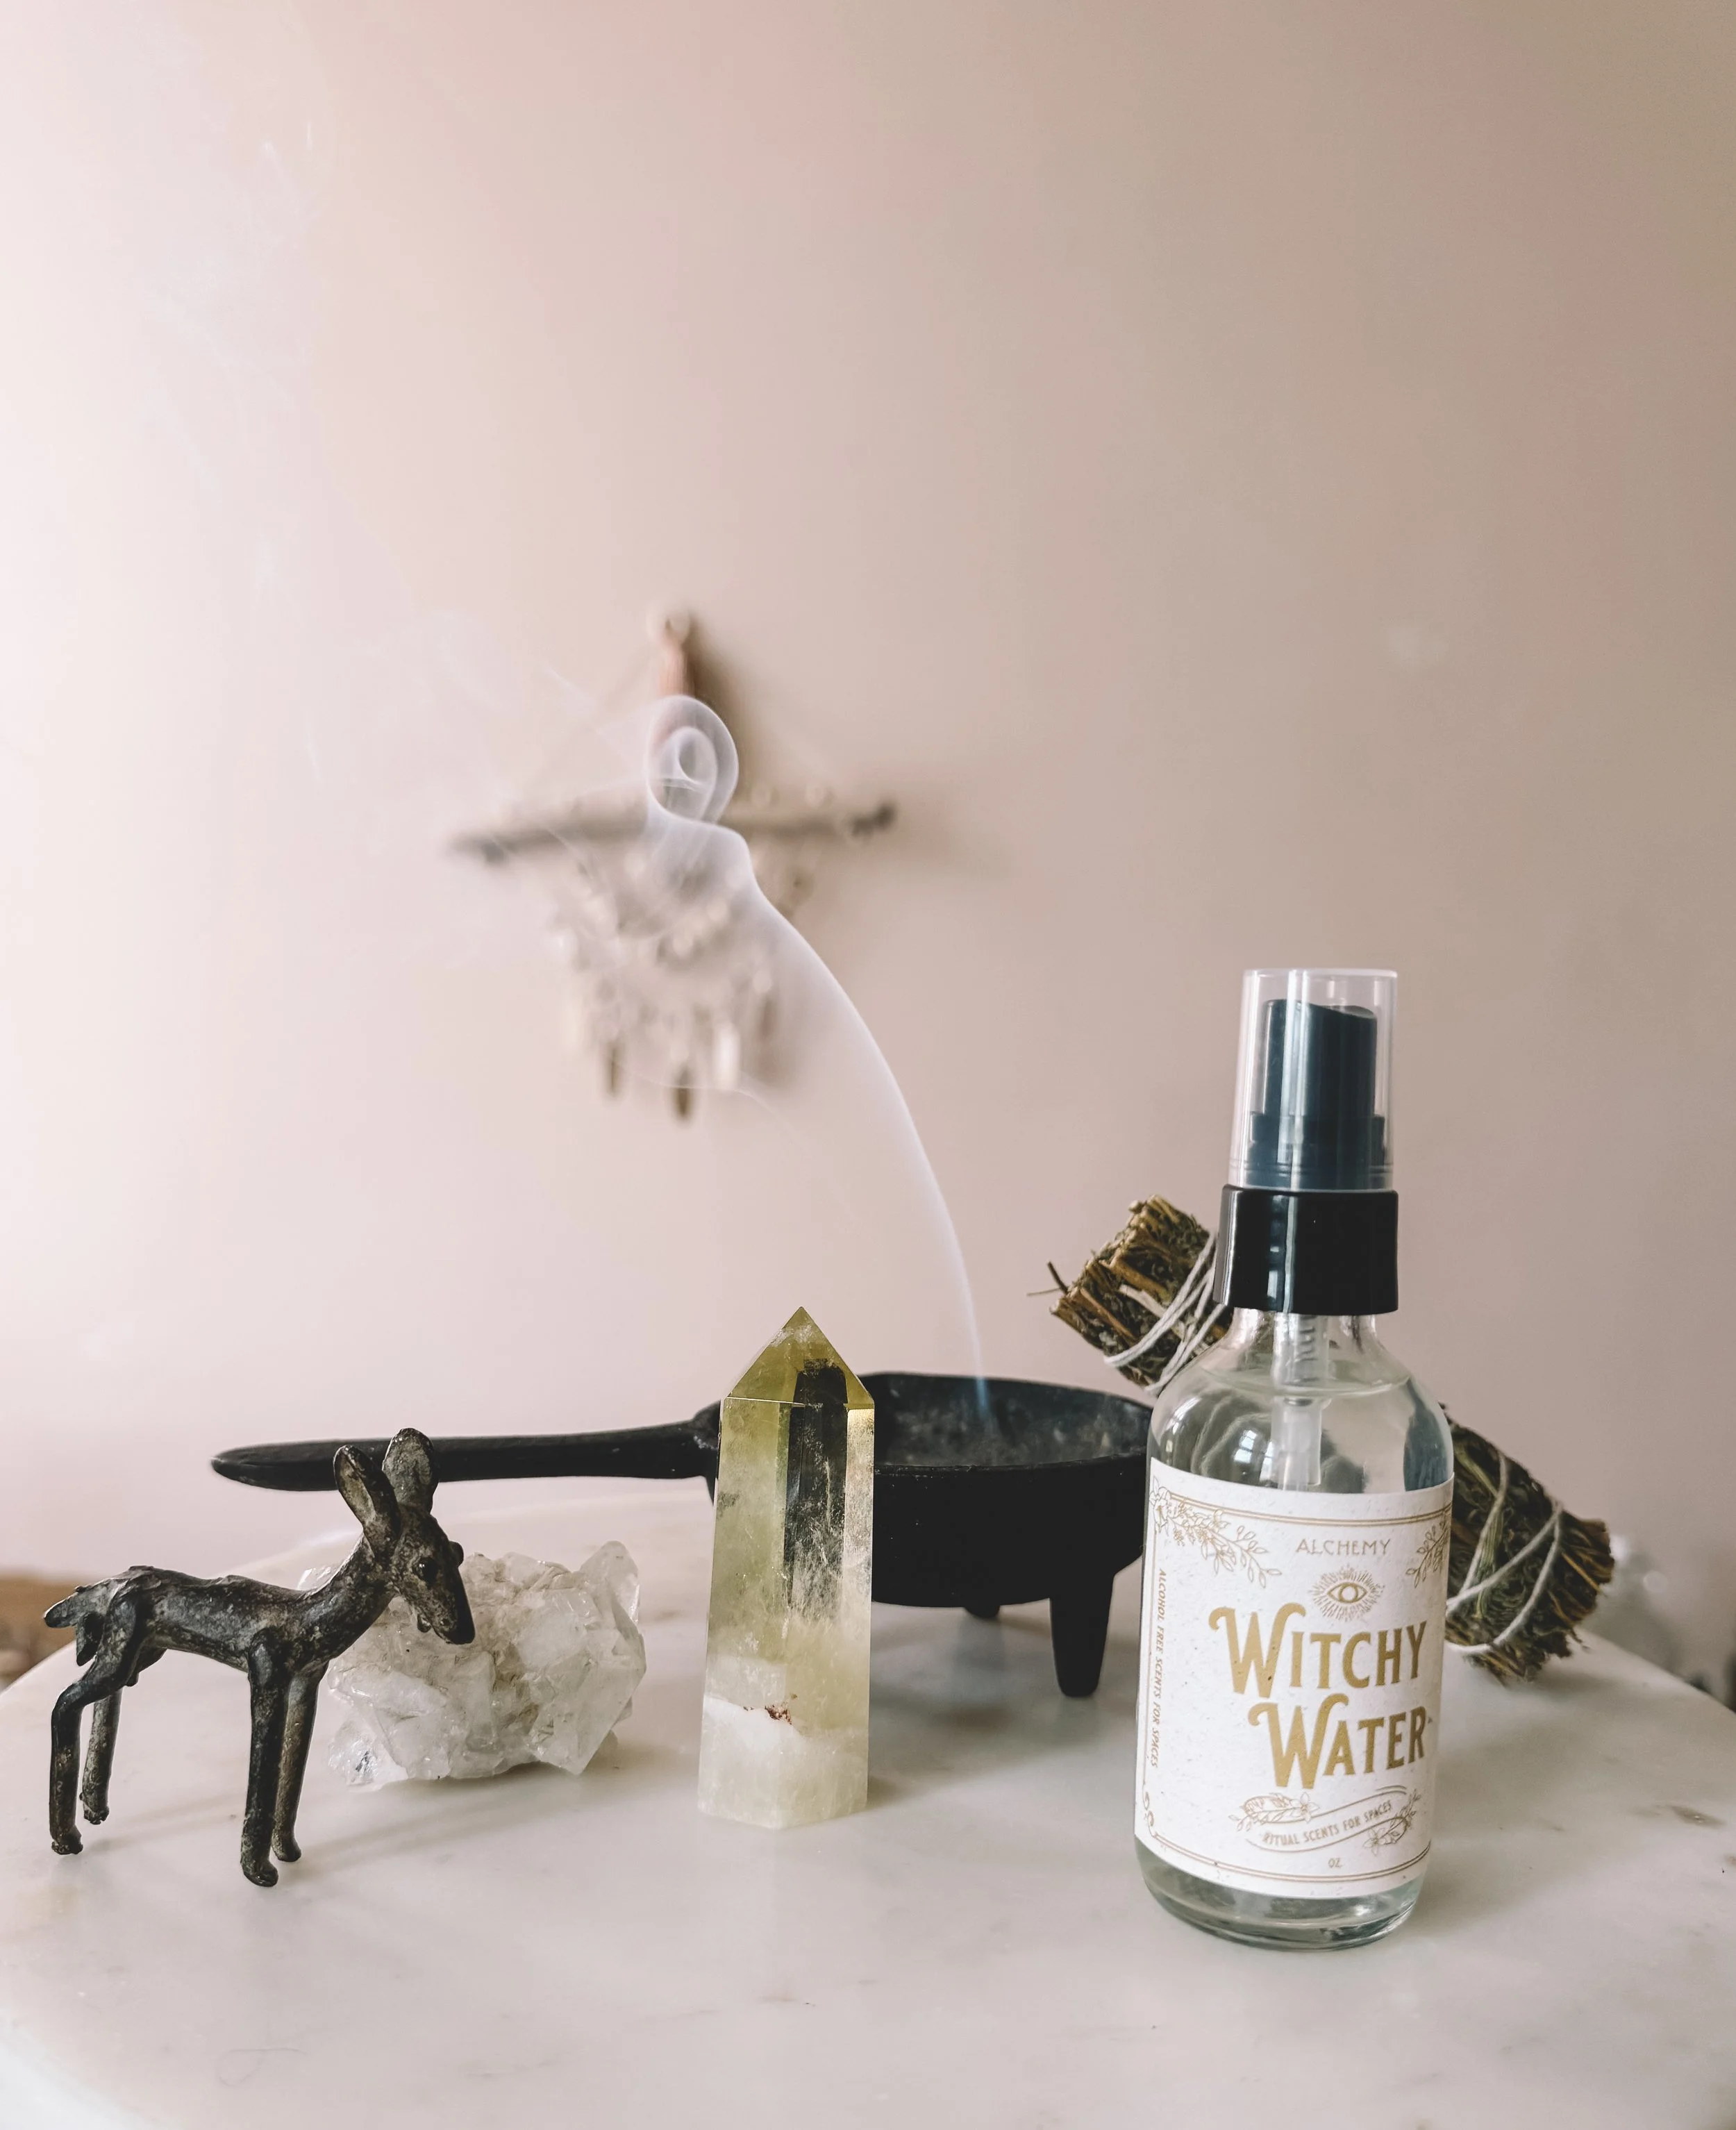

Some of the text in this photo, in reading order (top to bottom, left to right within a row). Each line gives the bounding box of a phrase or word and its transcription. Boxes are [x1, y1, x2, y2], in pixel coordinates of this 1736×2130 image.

[1295, 1538, 1391, 1556] ALCHEMY
[1150, 1567, 1167, 1768] ALCOHOL FREE SCENTS FOR SPACES
[1208, 1601, 1428, 1699] WITCHY
[1247, 1693, 1427, 1790] WATER
[1262, 1799, 1393, 1847] RITUAL SCENTS FOR SPACES
